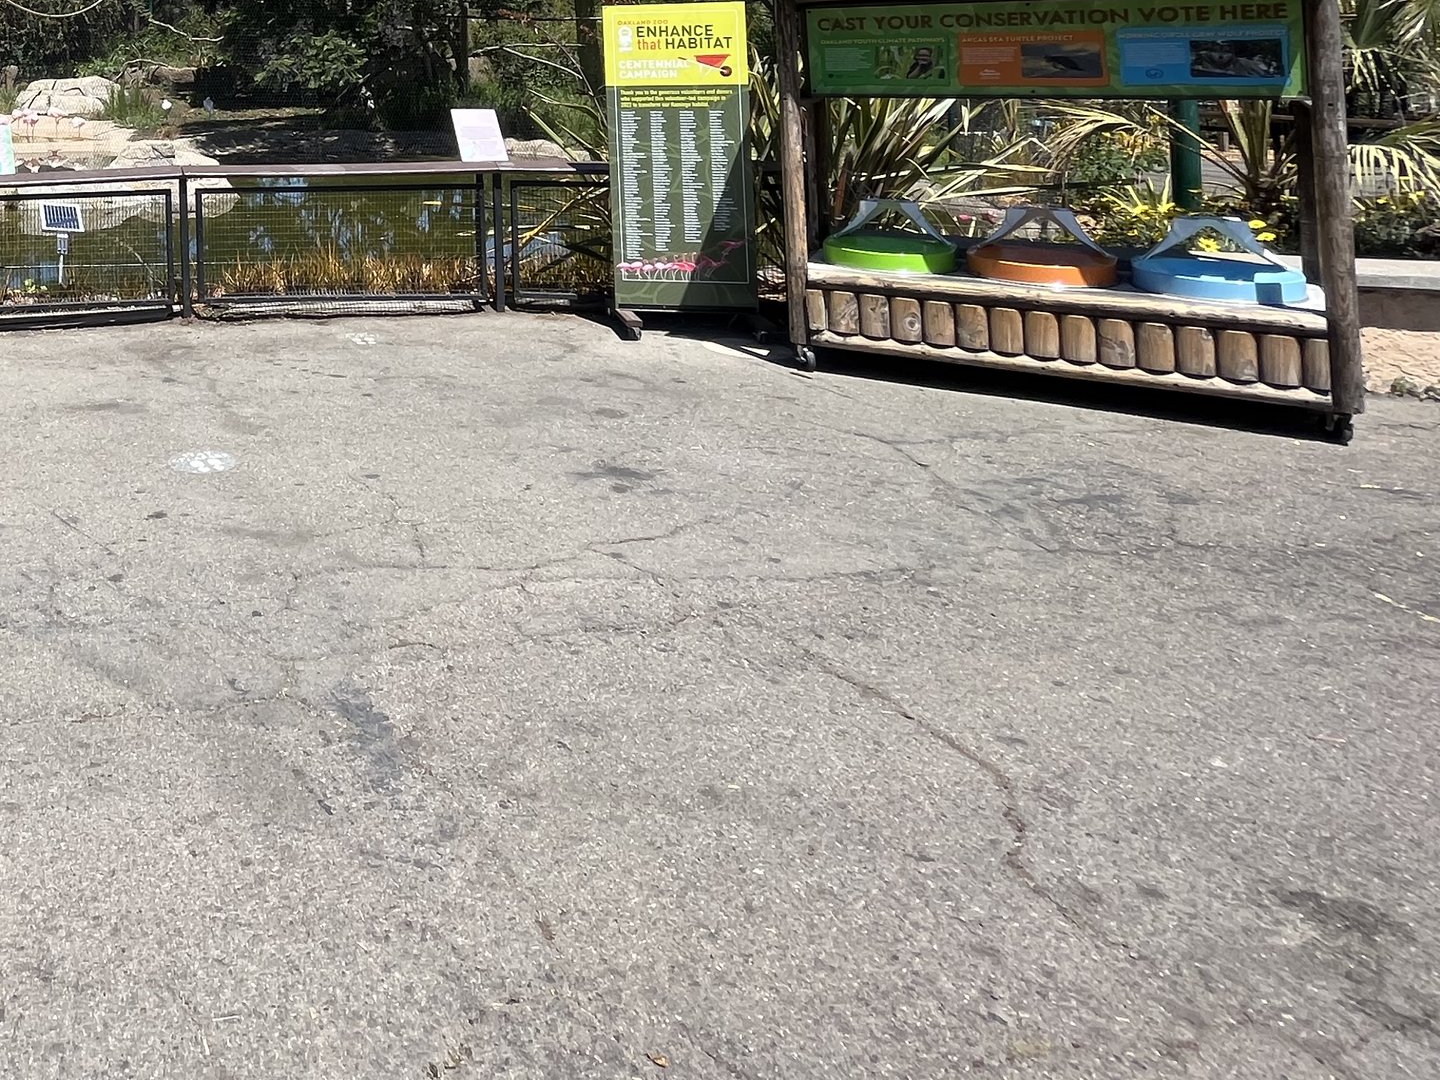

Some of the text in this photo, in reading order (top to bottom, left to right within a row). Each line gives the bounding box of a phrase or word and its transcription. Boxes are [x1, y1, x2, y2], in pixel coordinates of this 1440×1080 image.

[817, 2, 1288, 31] CAST YOUR CONSERVATION VOTE HERE
[636, 25, 714, 37] ENHANCE
[637, 36, 732, 50] that HABITAT
[619, 60, 689, 70] CENTENNIAL
[619, 70, 678, 79] CAMPAIGN
